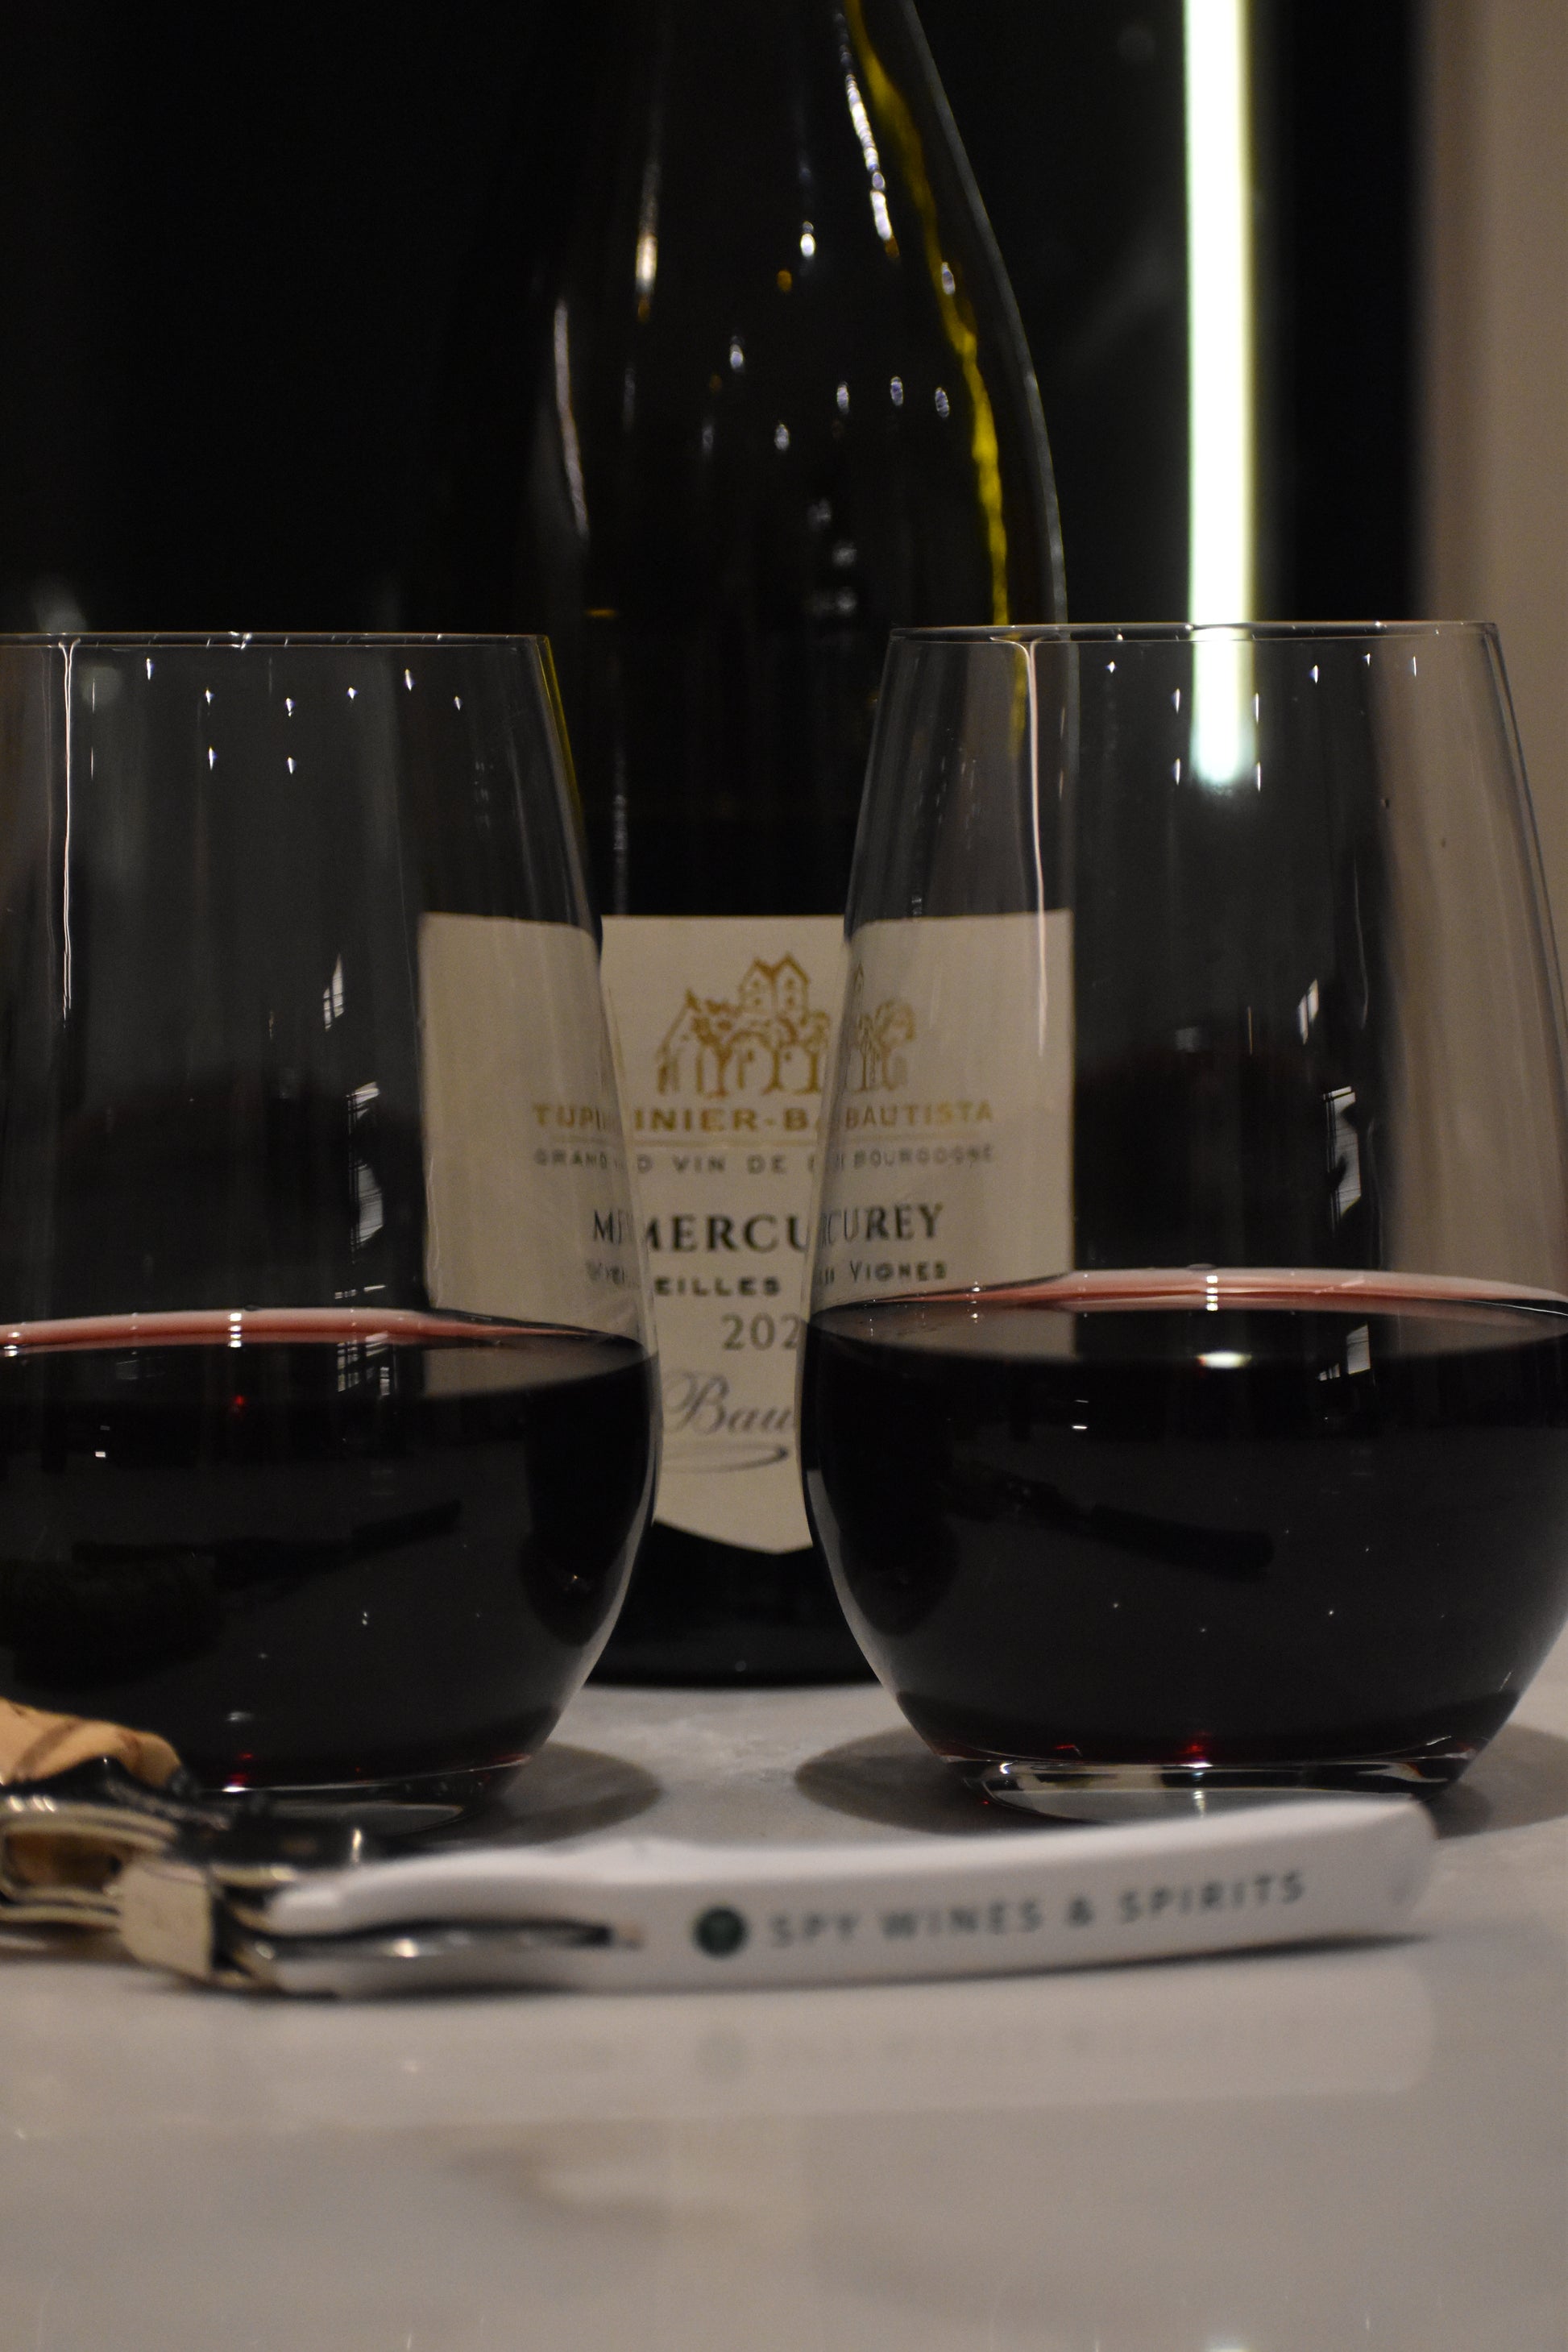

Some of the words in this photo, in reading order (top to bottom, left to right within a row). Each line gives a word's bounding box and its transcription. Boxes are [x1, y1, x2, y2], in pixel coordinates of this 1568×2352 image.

[672, 1154, 725, 1174] VIN
[747, 1153, 786, 1175] DE
[769, 1909, 861, 1950] SPY
[881, 1895, 1042, 1941] WINES
[1065, 1891, 1095, 1927] &
[1119, 1868, 1305, 1925] SPIRITS
